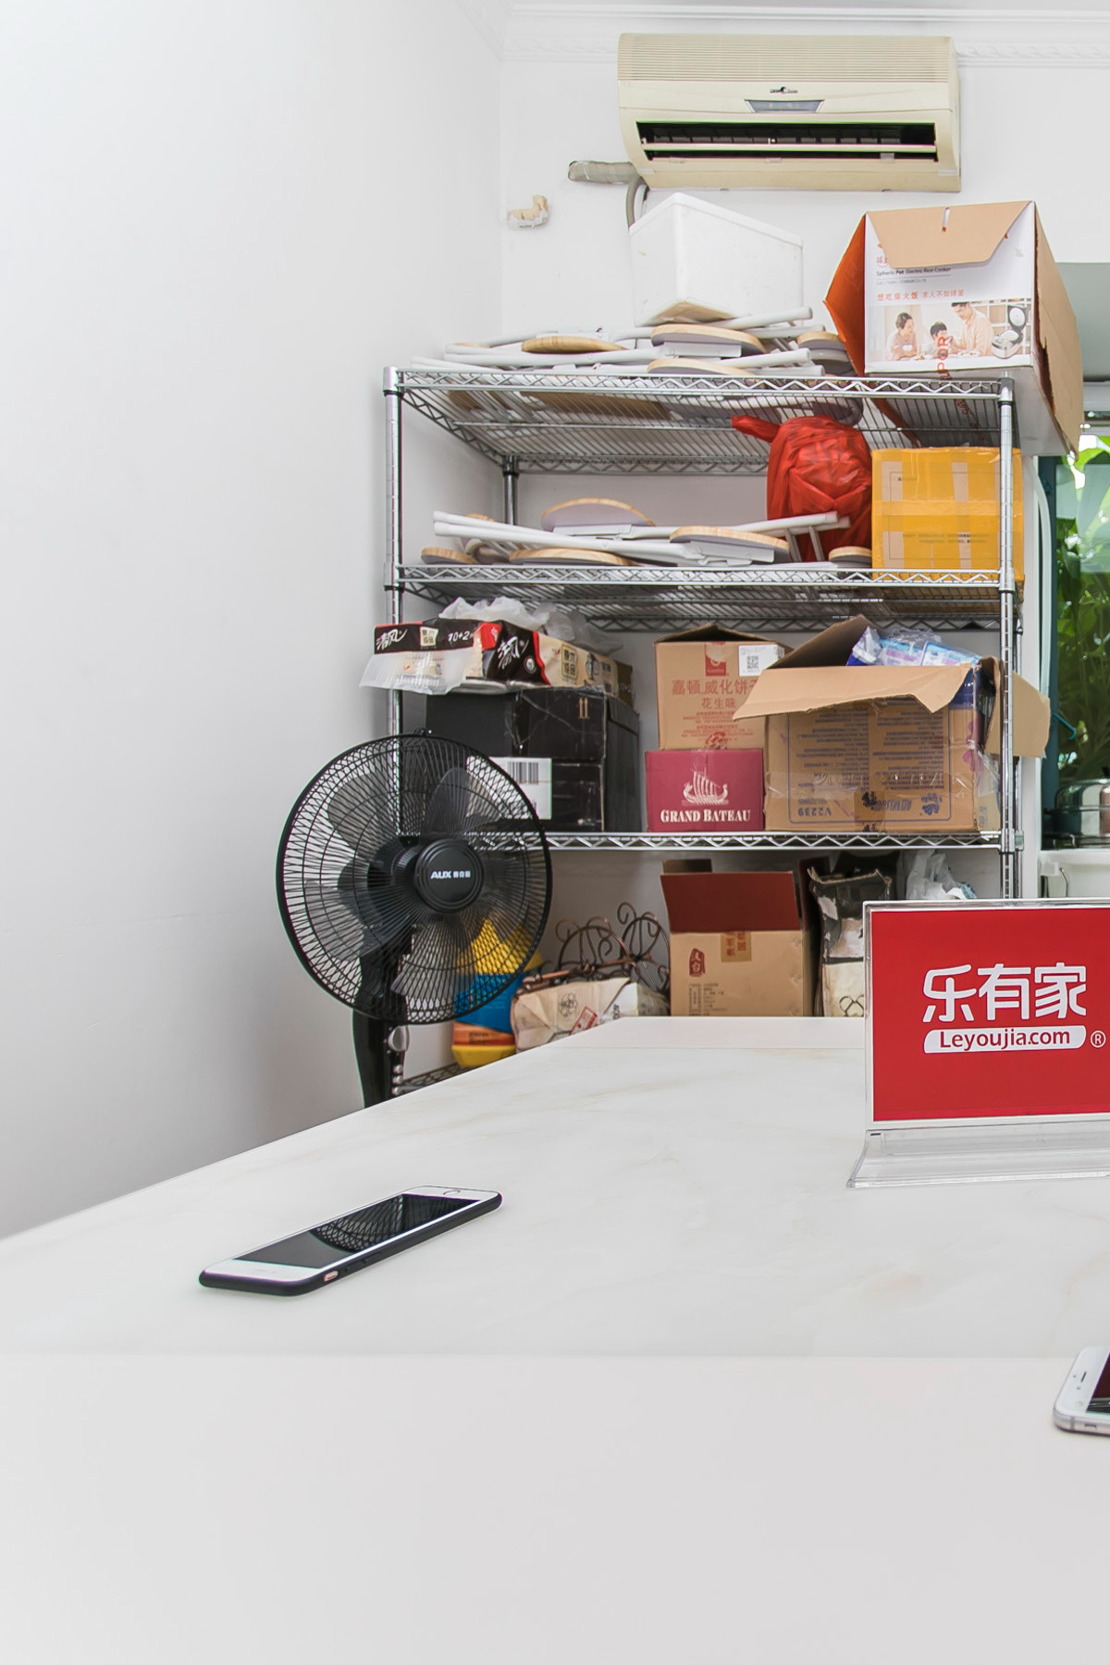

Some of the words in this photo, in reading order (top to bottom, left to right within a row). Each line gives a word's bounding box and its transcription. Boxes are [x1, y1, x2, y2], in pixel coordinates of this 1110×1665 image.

[660, 809, 701, 823] GRAND
[703, 808, 752, 823] BATEAU
[430, 870, 452, 880] AUX
[922, 962, 1087, 1023] 乐有家
[940, 1029, 1071, 1051] Leyoujia.com
